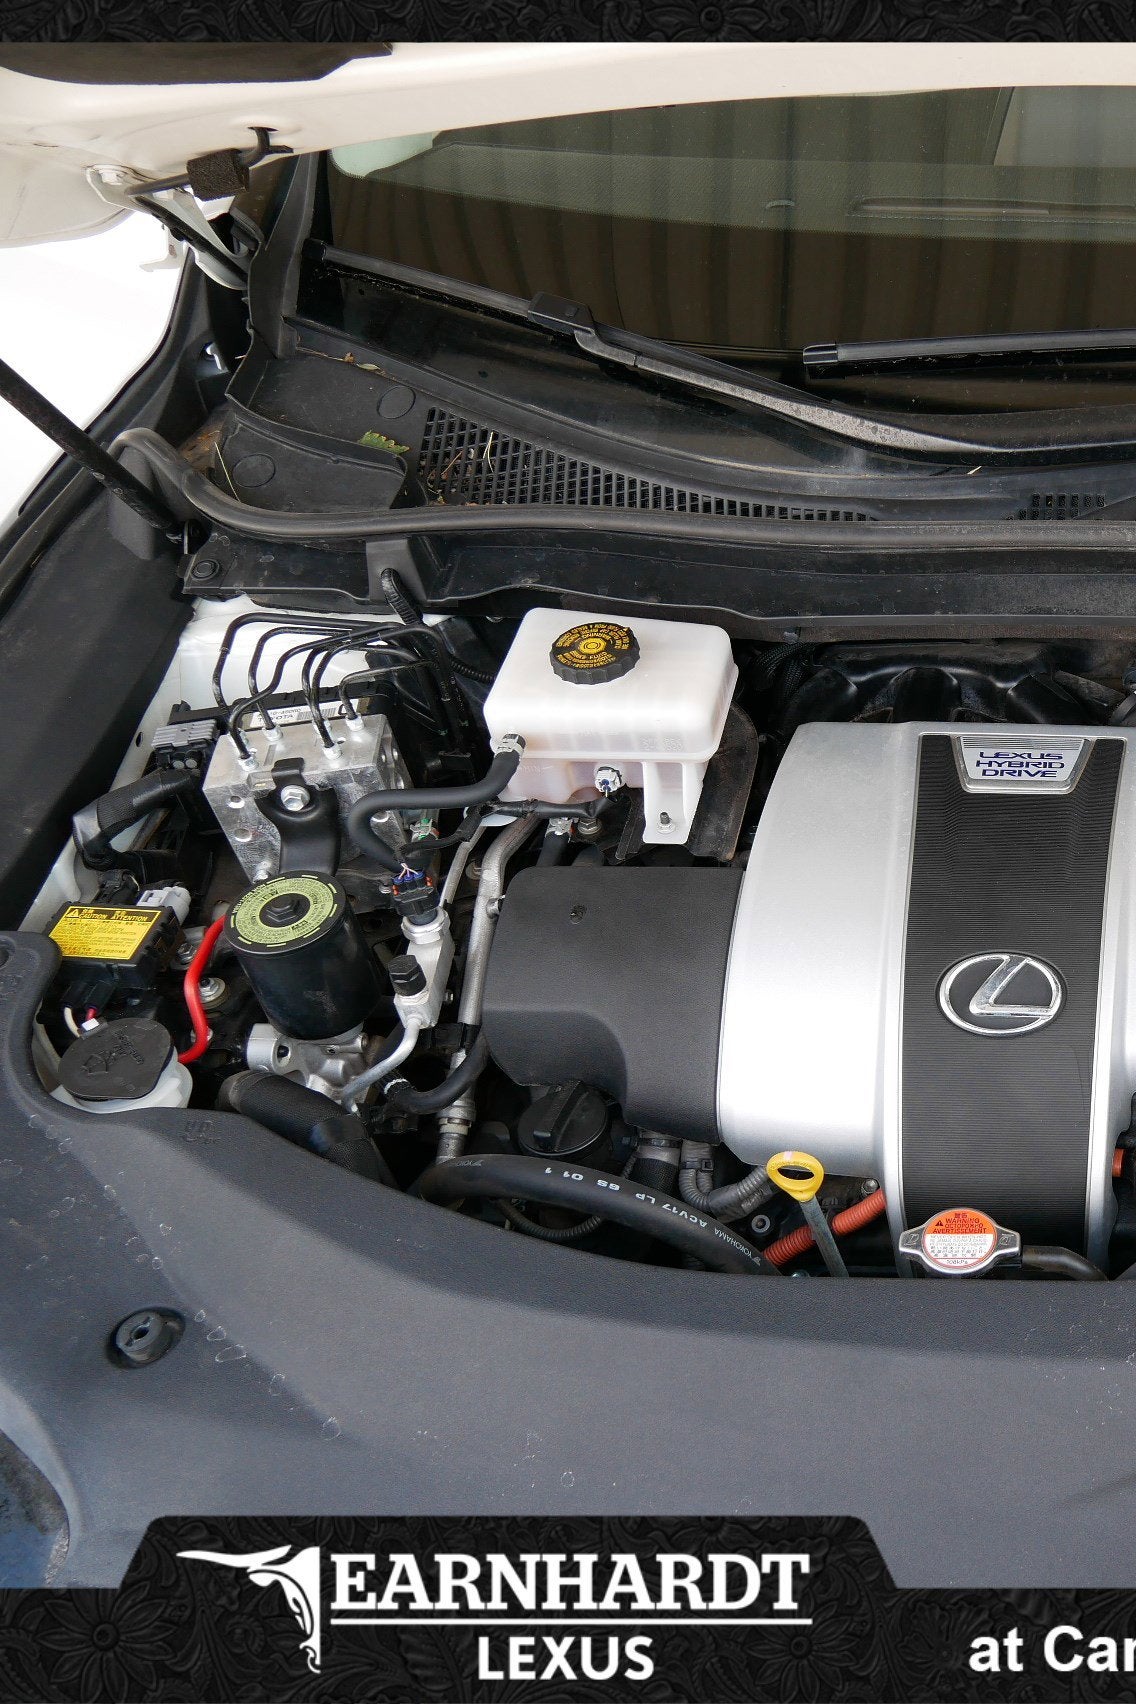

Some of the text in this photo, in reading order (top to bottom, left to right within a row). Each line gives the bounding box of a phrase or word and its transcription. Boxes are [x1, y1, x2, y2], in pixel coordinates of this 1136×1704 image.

[979, 751, 1063, 760] LEXUS
[975, 760, 1065, 769] HYBRID
[981, 769, 1058, 778] DRIVE
[79, 912, 107, 920] CAUTION
[635, 1192, 656, 1204] LP
[661, 1203, 708, 1228] ACV17
[714, 1227, 752, 1259] YOKOHAMA
